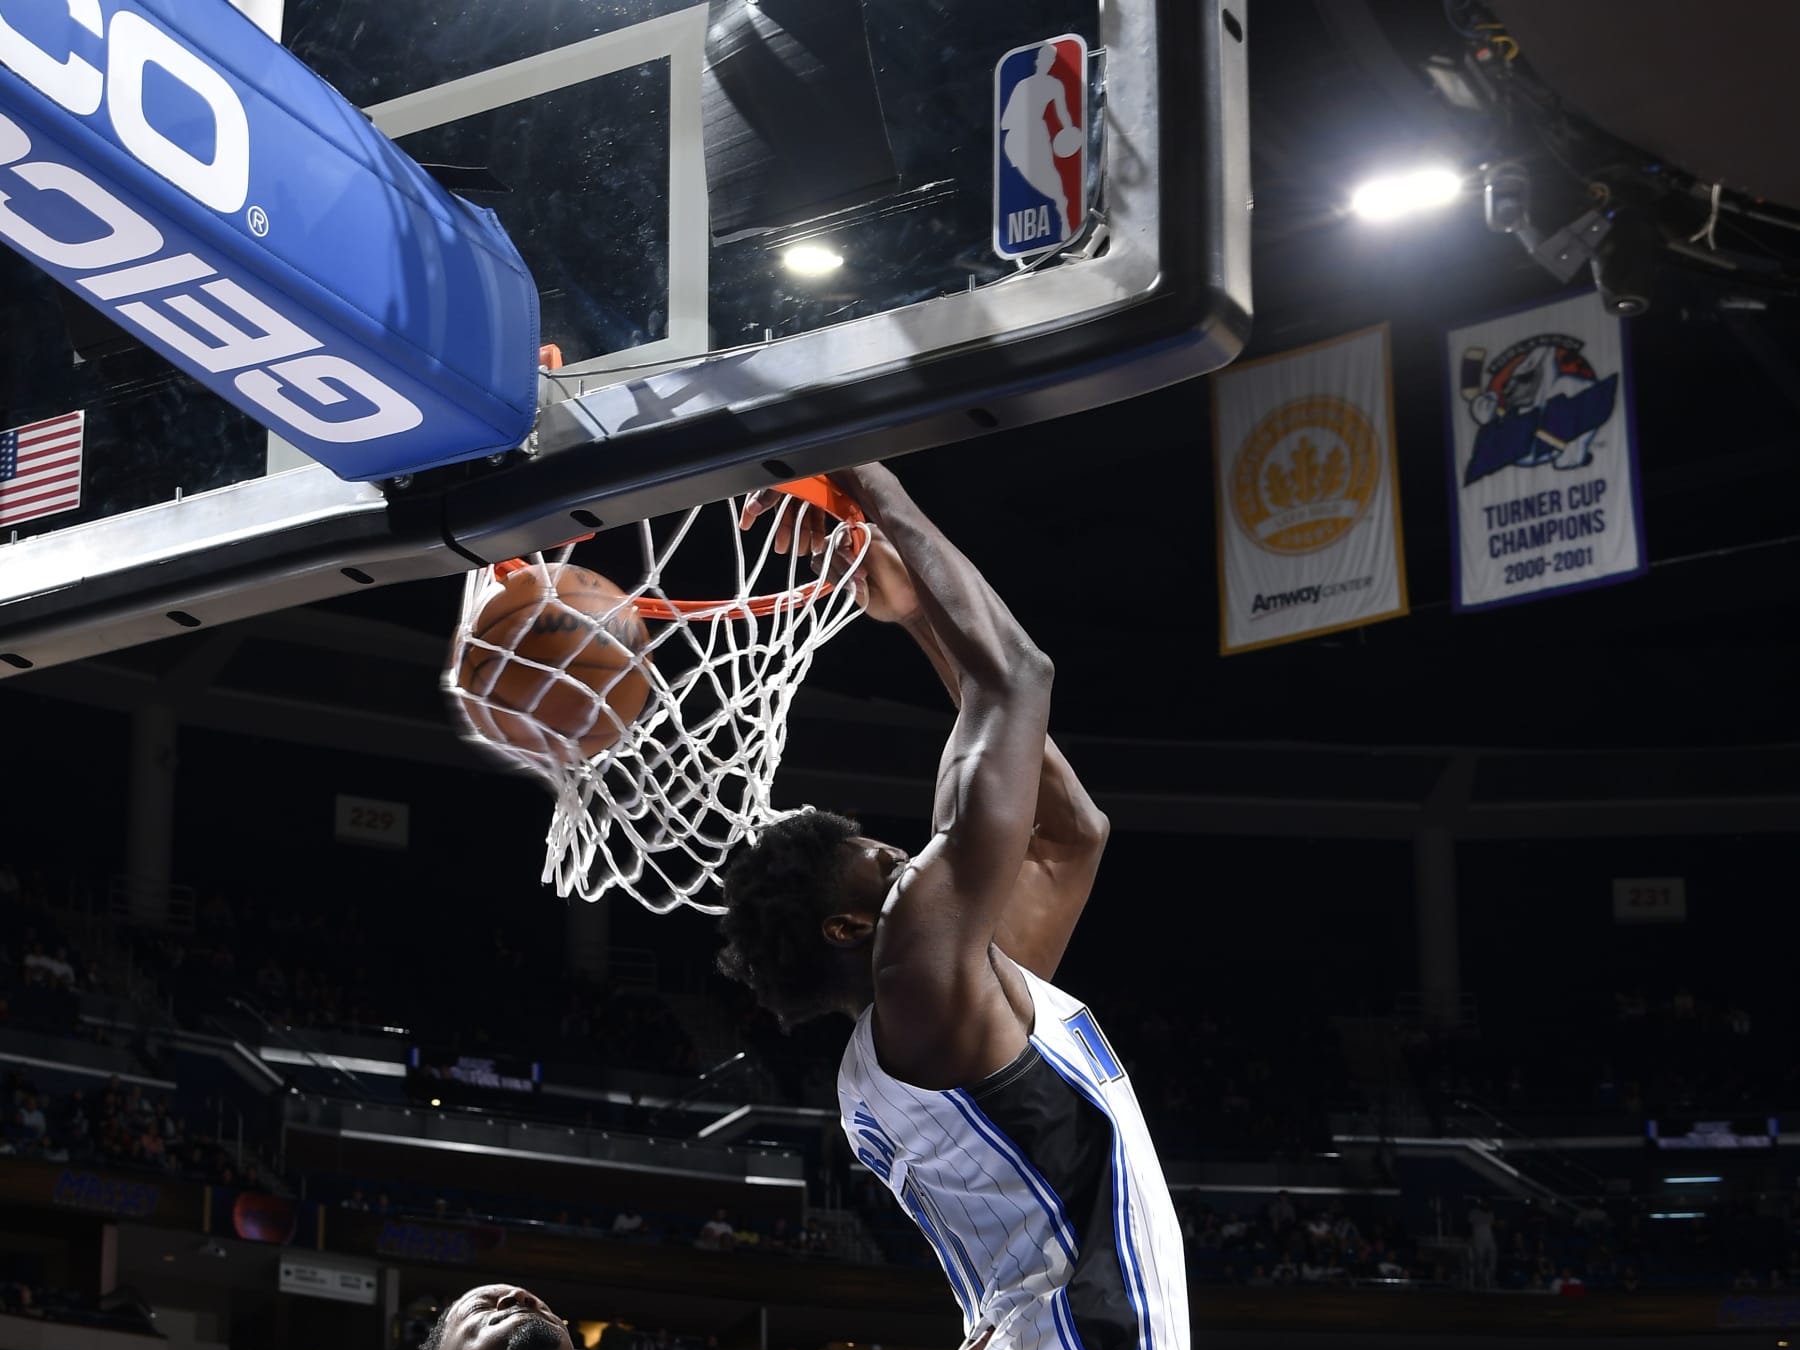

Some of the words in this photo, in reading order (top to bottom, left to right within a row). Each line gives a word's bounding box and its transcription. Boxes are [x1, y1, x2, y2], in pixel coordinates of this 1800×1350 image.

[1008, 204, 1050, 245] NBA
[0, 113, 424, 443] GEIC
[1483, 490, 1562, 530] TURNER
[1568, 479, 1606, 510] CUP
[1488, 509, 1605, 558] CHAMPIONS
[1505, 547, 1594, 584] 2000-2001
[352, 807, 394, 832] 229
[1628, 887, 1670, 907] 231
